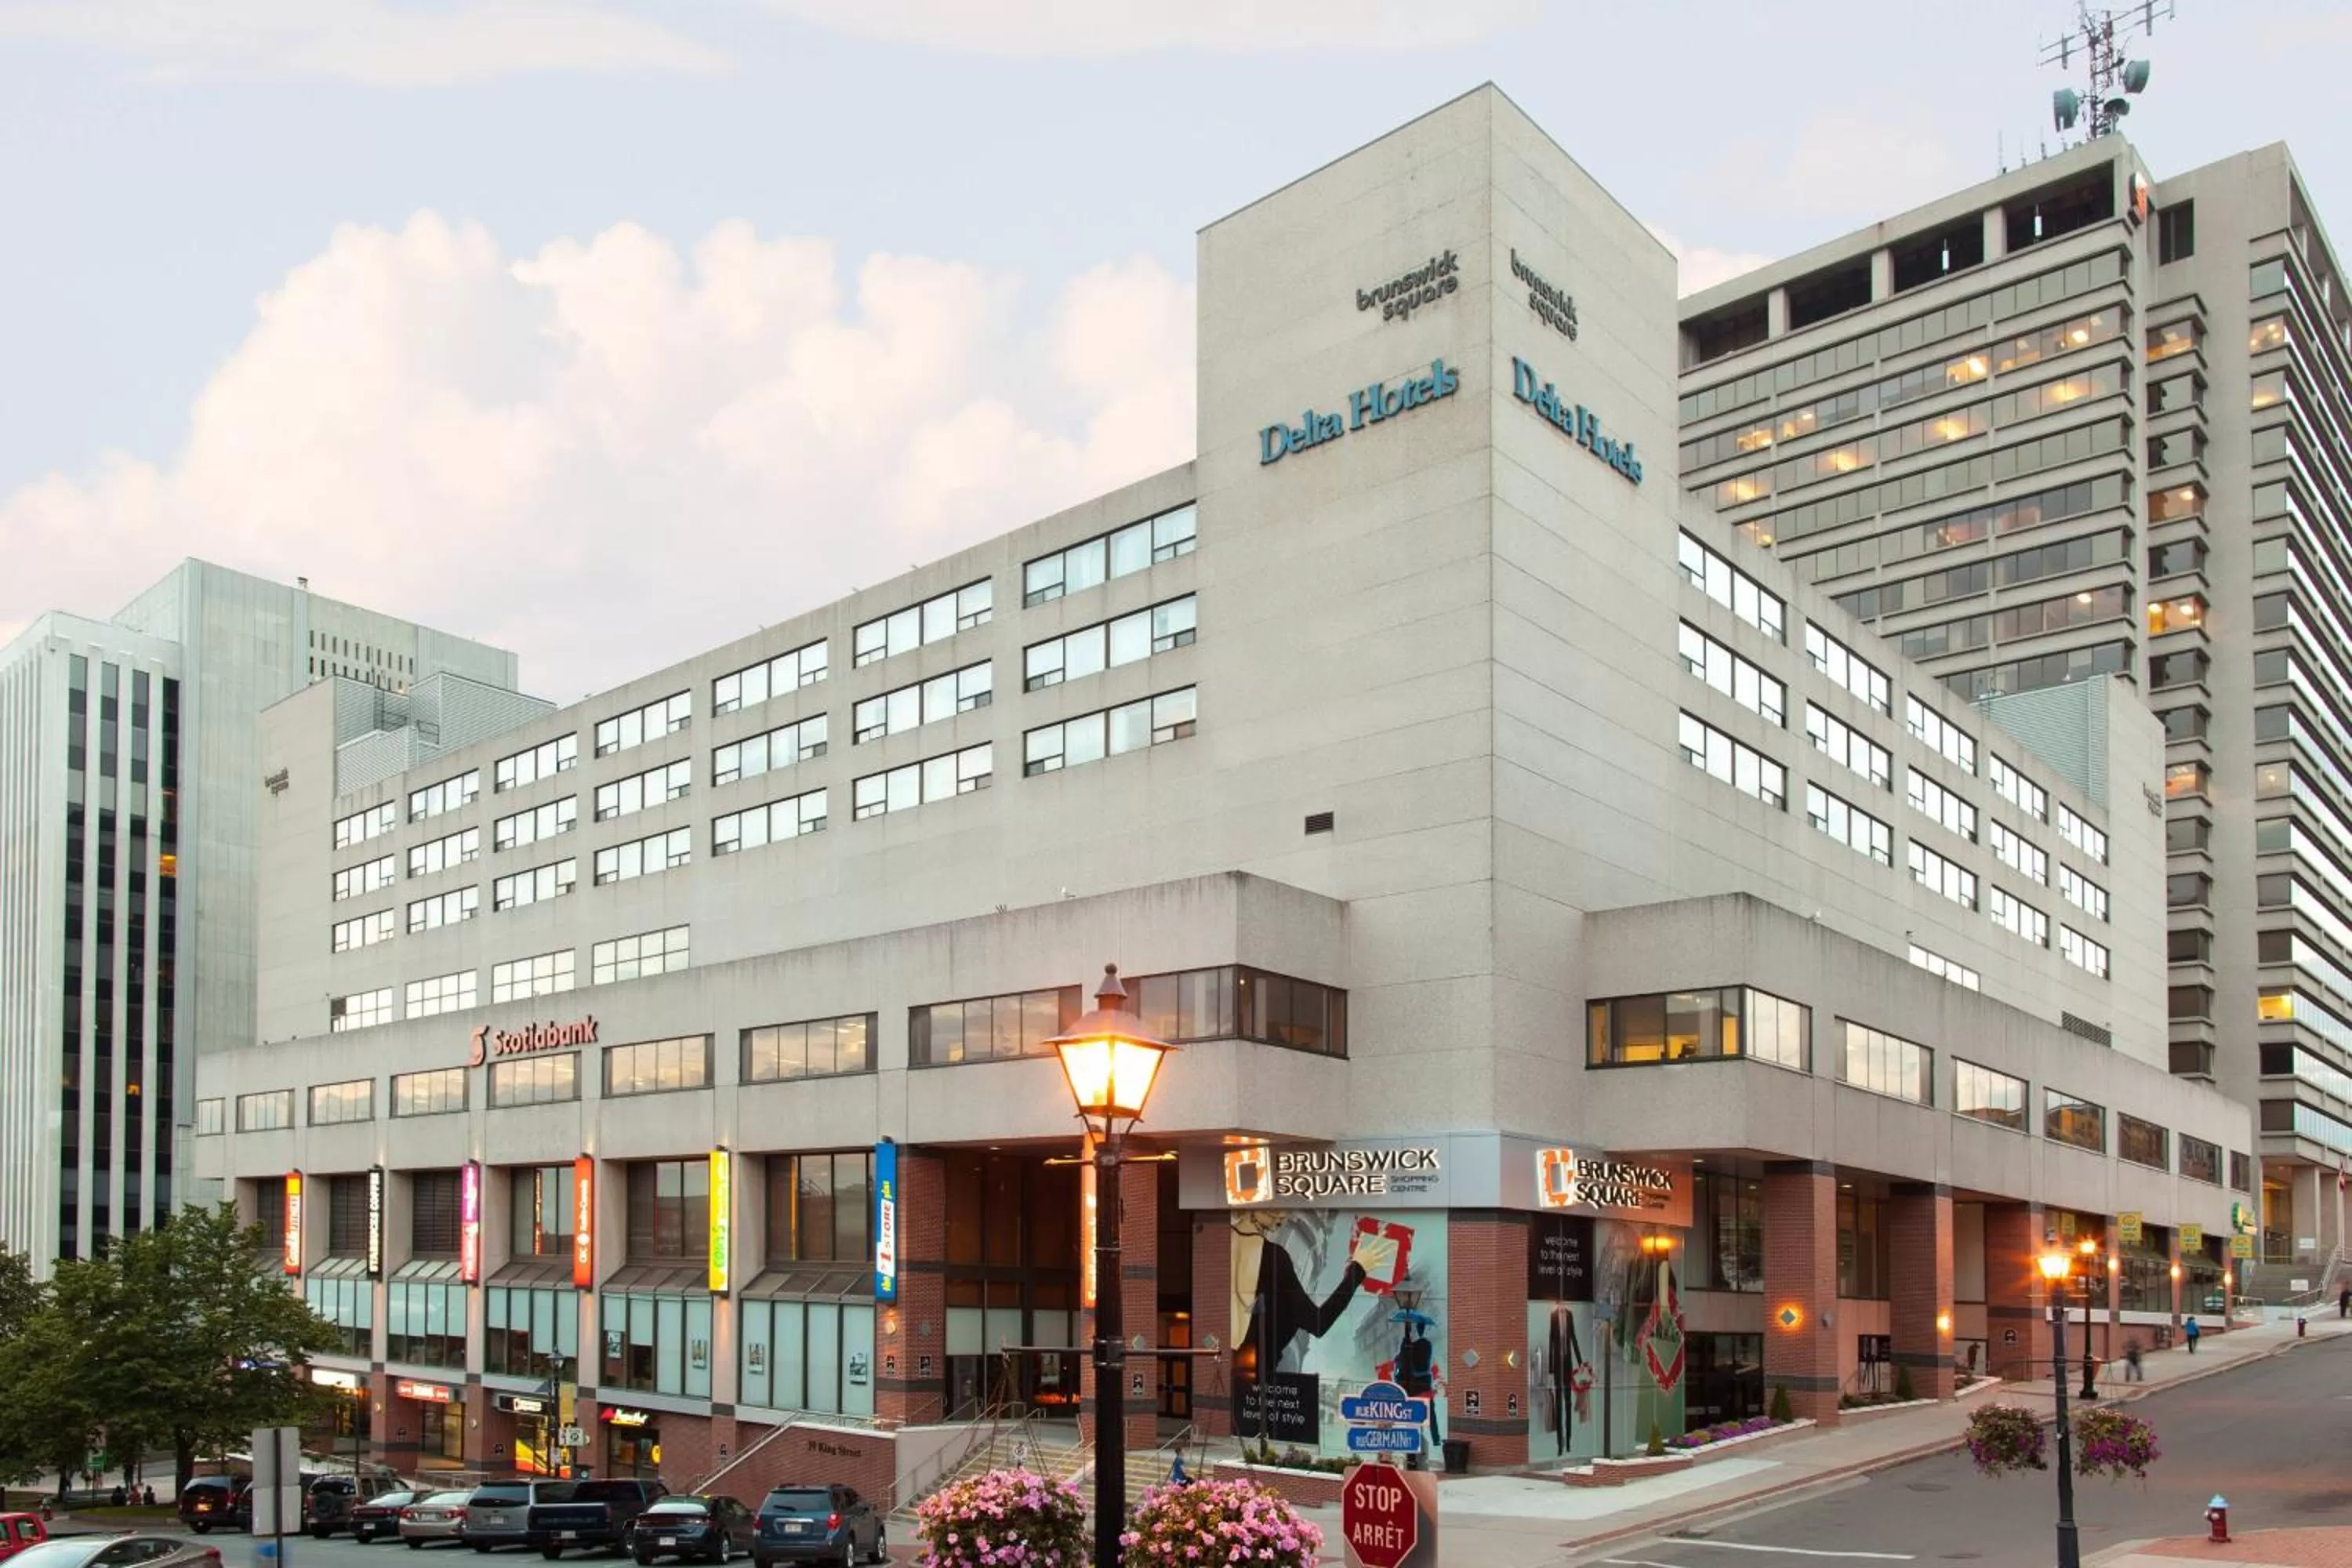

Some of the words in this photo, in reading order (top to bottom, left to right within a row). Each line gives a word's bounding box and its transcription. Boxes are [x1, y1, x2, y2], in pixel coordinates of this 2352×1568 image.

[1356, 249, 1459, 311] brunswick
[1510, 247, 1578, 325] brunswick
[1382, 275, 1458, 321] square
[1528, 291, 1577, 342] square
[1259, 408, 1344, 466] Delta
[1348, 358, 1459, 431] Hotels
[1512, 356, 1573, 434] Delta
[1576, 403, 1643, 486] Hotels
[492, 1014, 599, 1056] Scotiabank
[1276, 1148, 1441, 1173] BRUNSWICK
[1576, 1158, 1674, 1191] BRUNSWICK
[369, 1172, 379, 1211] COFFEE
[881, 1181, 893, 1200] plus
[1276, 1174, 1386, 1200] SQUARE
[1576, 1182, 1643, 1210] SQUARE
[883, 1203, 891, 1248] STORE
[369, 1212, 379, 1272] STARBUCKS
[881, 1276, 891, 1292] the
[1245, 1395, 1255, 1406] to
[1258, 1396, 1276, 1408] te
[1277, 1399, 1300, 1410] next
[1252, 1385, 1298, 1396] wcome
[1243, 1408, 1262, 1420] leve
[1268, 1411, 1279, 1422] of
[1282, 1411, 1305, 1425] style
[1370, 1400, 1403, 1419] KING
[1402, 1409, 1413, 1420] ST
[818, 1442, 837, 1456] King
[837, 1444, 862, 1457] Street
[1366, 1430, 1407, 1448] GERMAIN
[1354, 1483, 1402, 1513] STOP
[1352, 1519, 1405, 1551] ARRÊT
